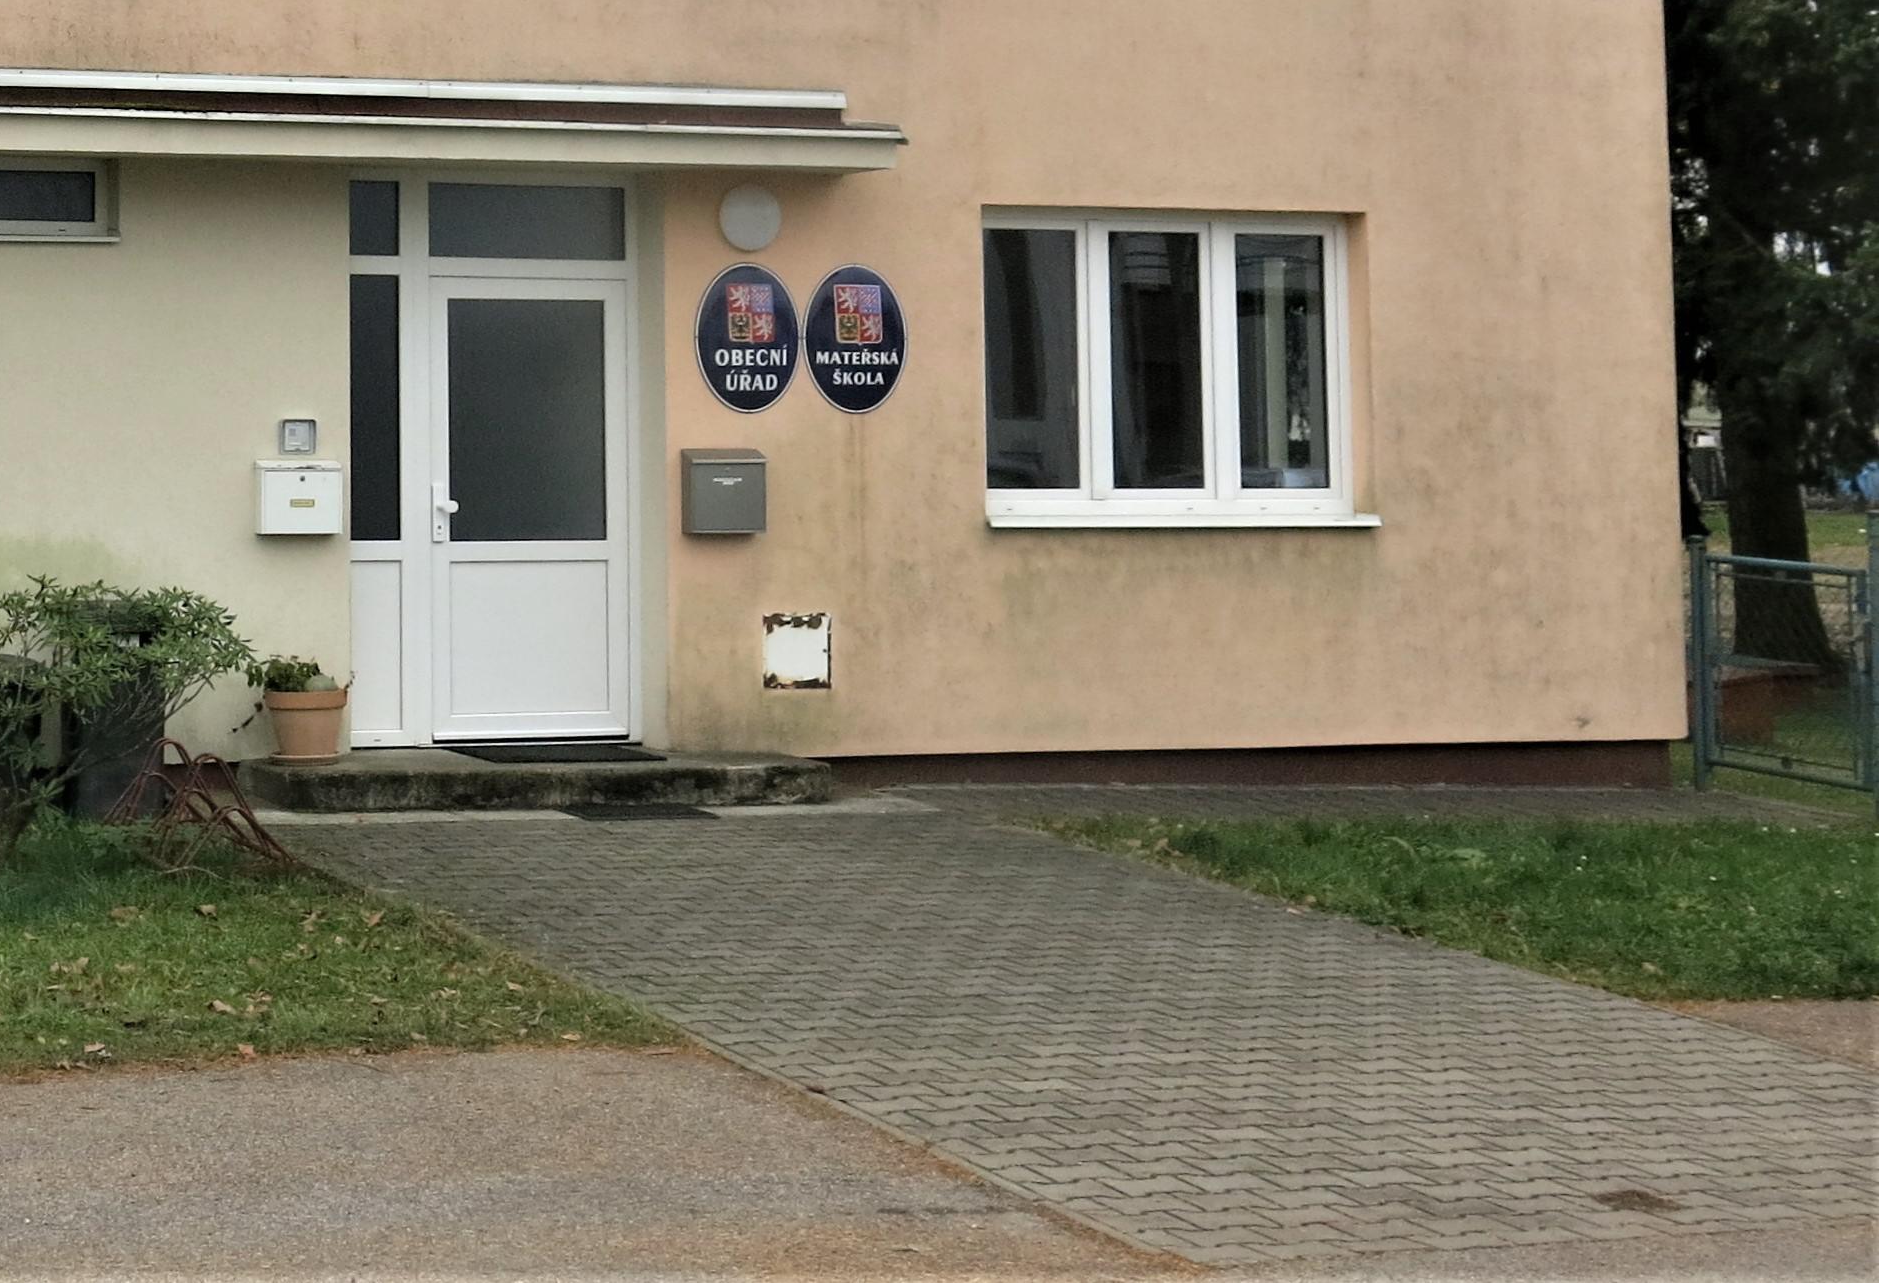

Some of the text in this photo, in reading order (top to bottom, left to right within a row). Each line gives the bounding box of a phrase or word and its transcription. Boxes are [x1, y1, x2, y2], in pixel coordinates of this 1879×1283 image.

[714, 344, 788, 366] OBECNÍ
[816, 348, 899, 366] MATEŘSKÁ
[726, 368, 779, 391] ÚŘAD
[832, 368, 885, 386] ŠKOLA
